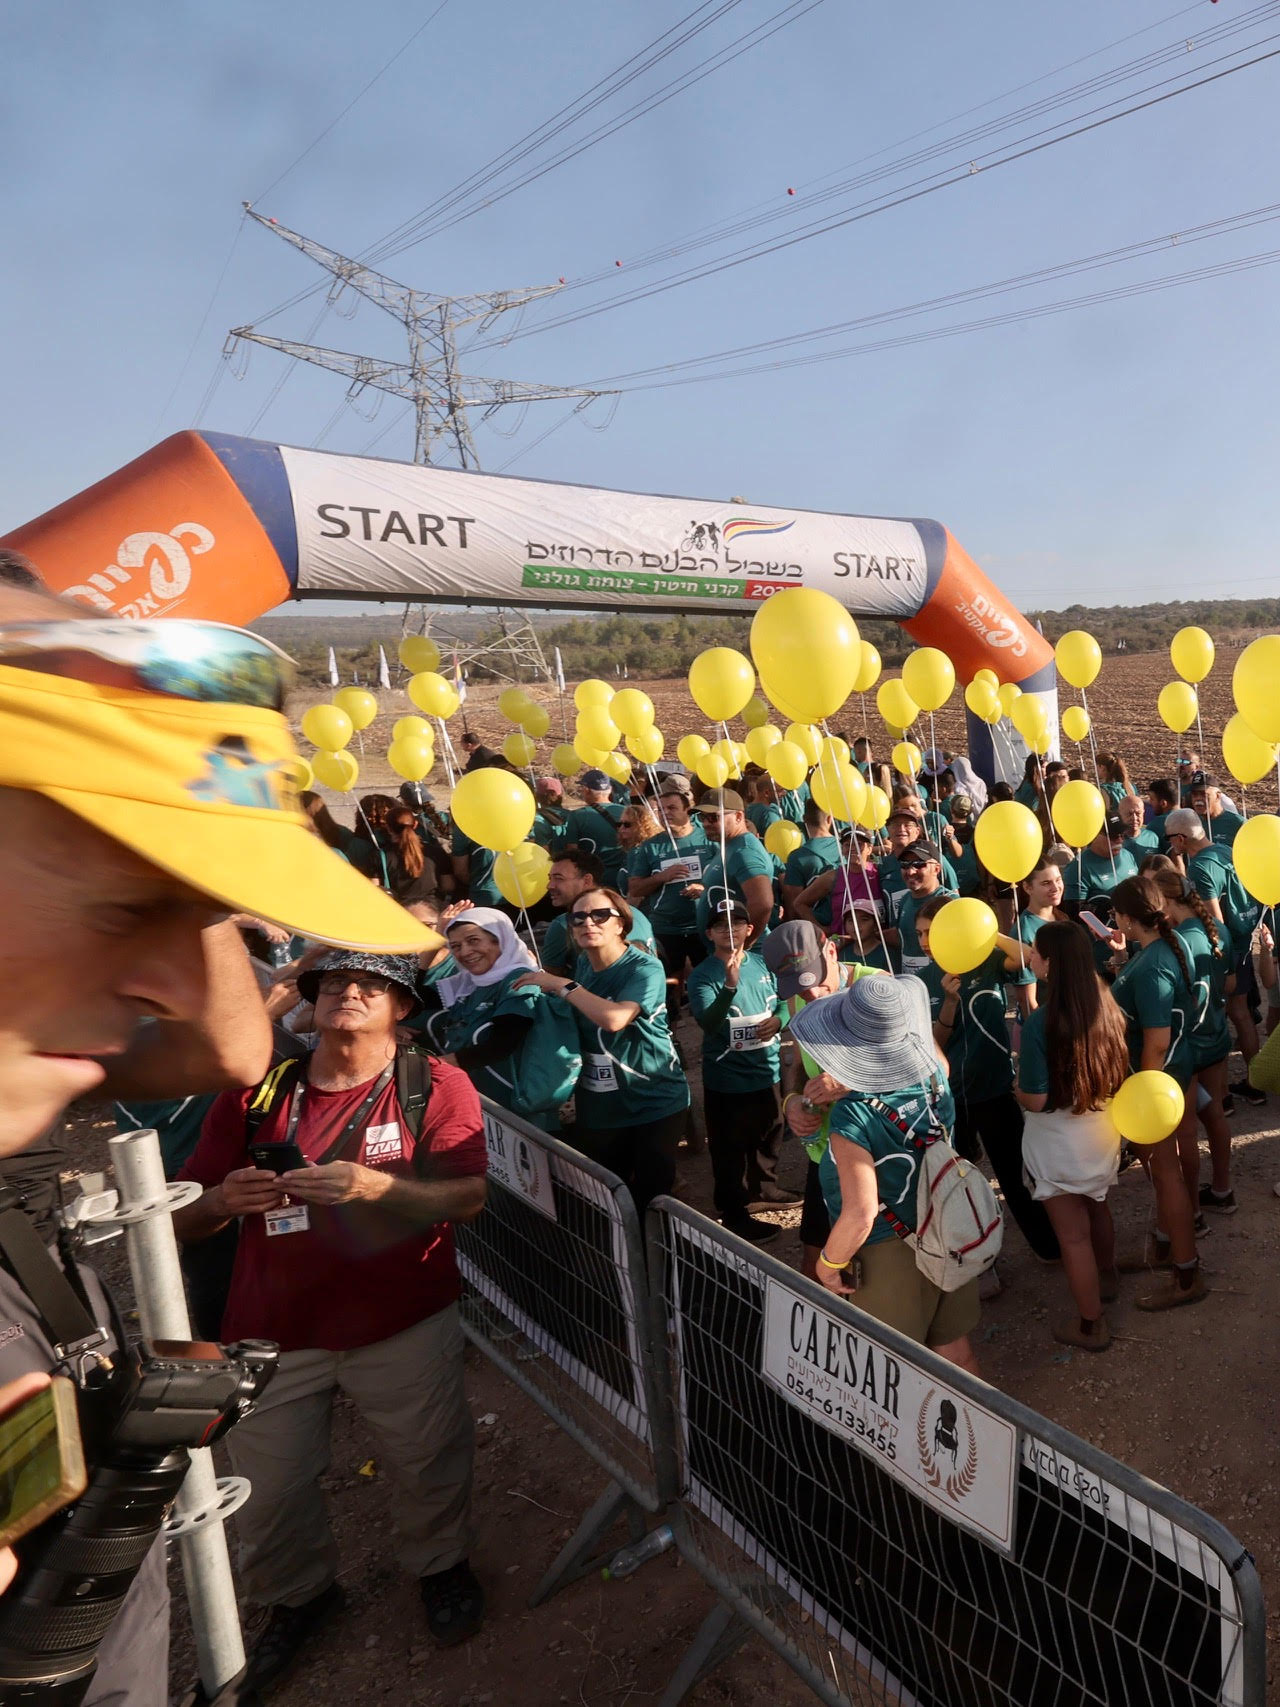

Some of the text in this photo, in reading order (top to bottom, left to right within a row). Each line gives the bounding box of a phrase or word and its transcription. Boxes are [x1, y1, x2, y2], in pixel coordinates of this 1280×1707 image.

[317, 503, 475, 549] START
[525, 540, 804, 578] בשביל הבנים הדרוזים
[833, 552, 916, 581] START
[534, 571, 580, 586] גולני
[587, 576, 634, 589] צומת
[653, 579, 698, 593] חיטין
[704, 583, 739, 596] קרני
[751, 585, 786, 597] 202
[787, 1355, 832, 1393] לארועים
[790, 1301, 900, 1420] CAESAR
[786, 1373, 897, 1460] 054-6133455
